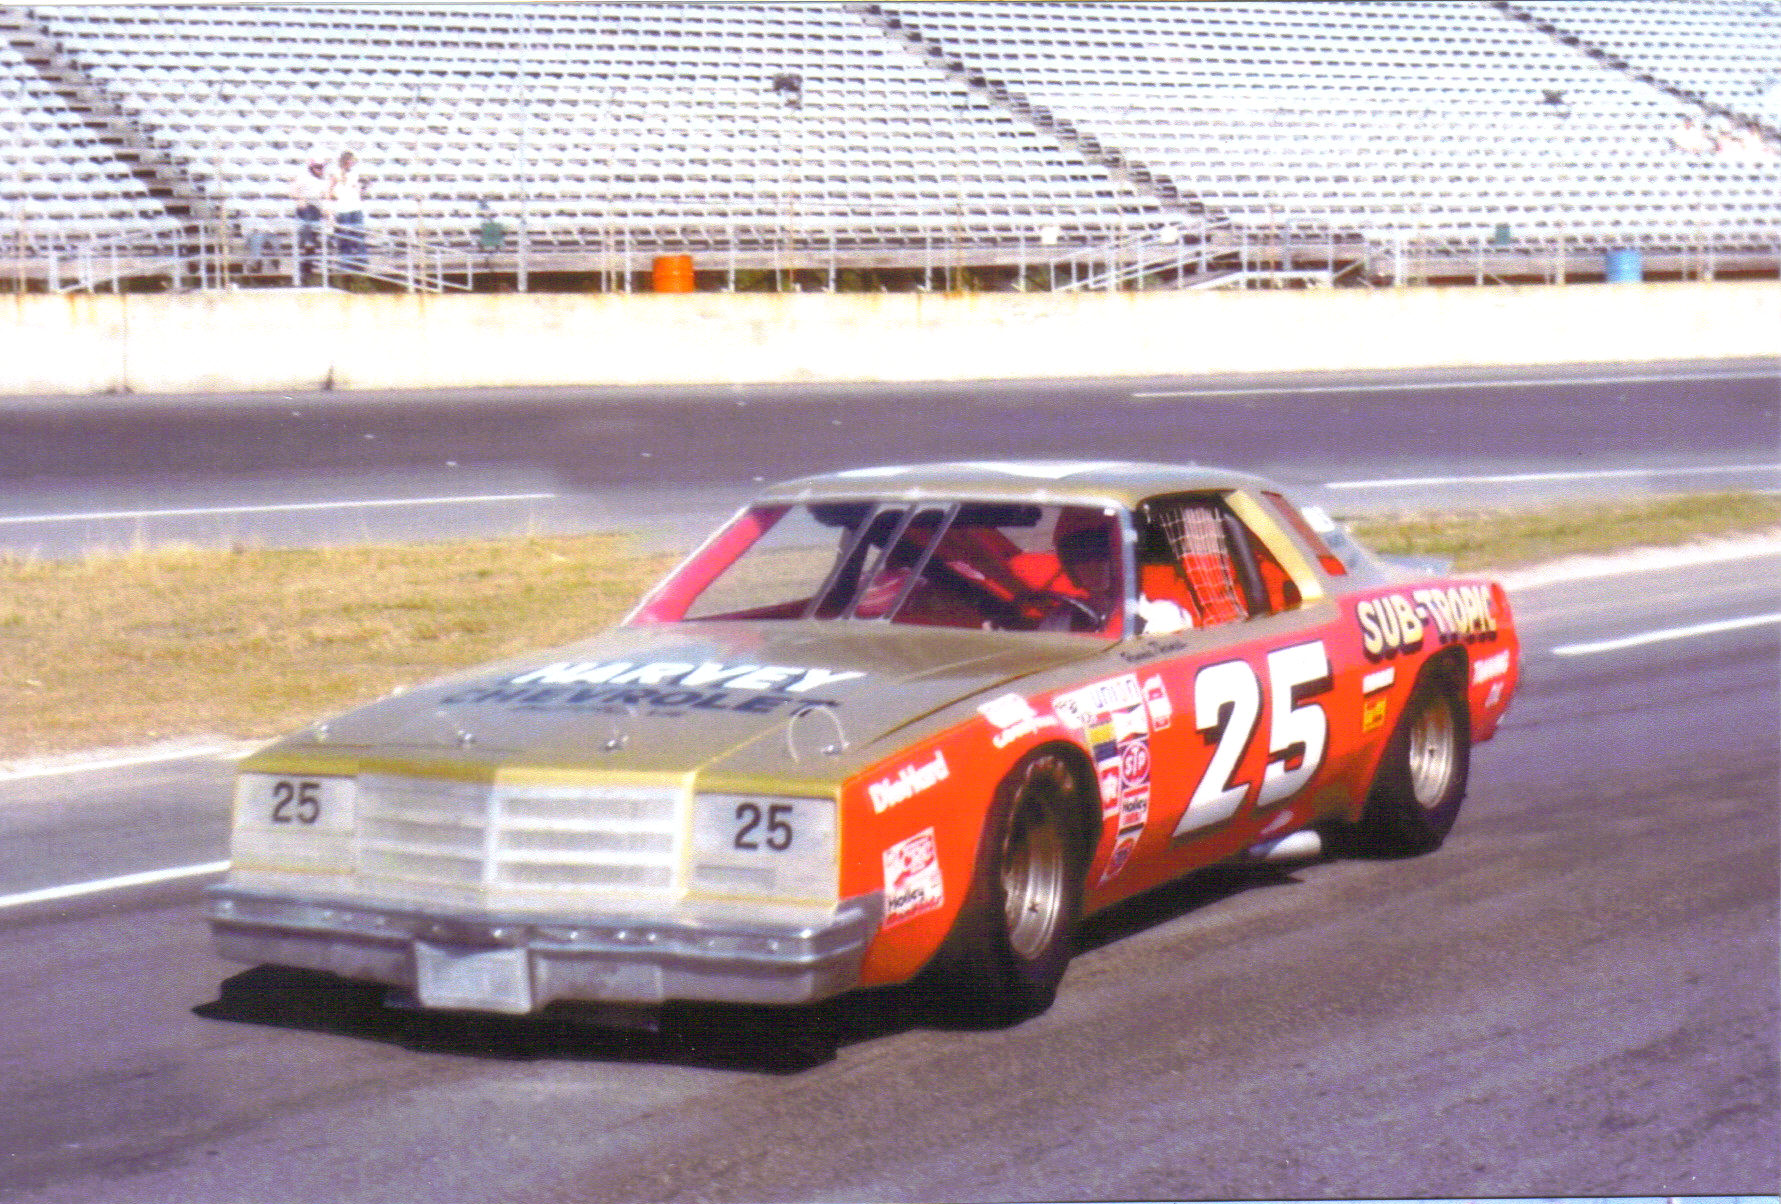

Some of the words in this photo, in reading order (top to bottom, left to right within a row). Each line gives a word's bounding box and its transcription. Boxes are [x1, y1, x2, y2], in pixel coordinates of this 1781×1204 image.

[510, 661, 868, 693] HARVEY
[1172, 640, 1330, 837] 25
[271, 781, 321, 825] 25
[868, 749, 951, 815] DieHard
[733, 803, 794, 852] 25
